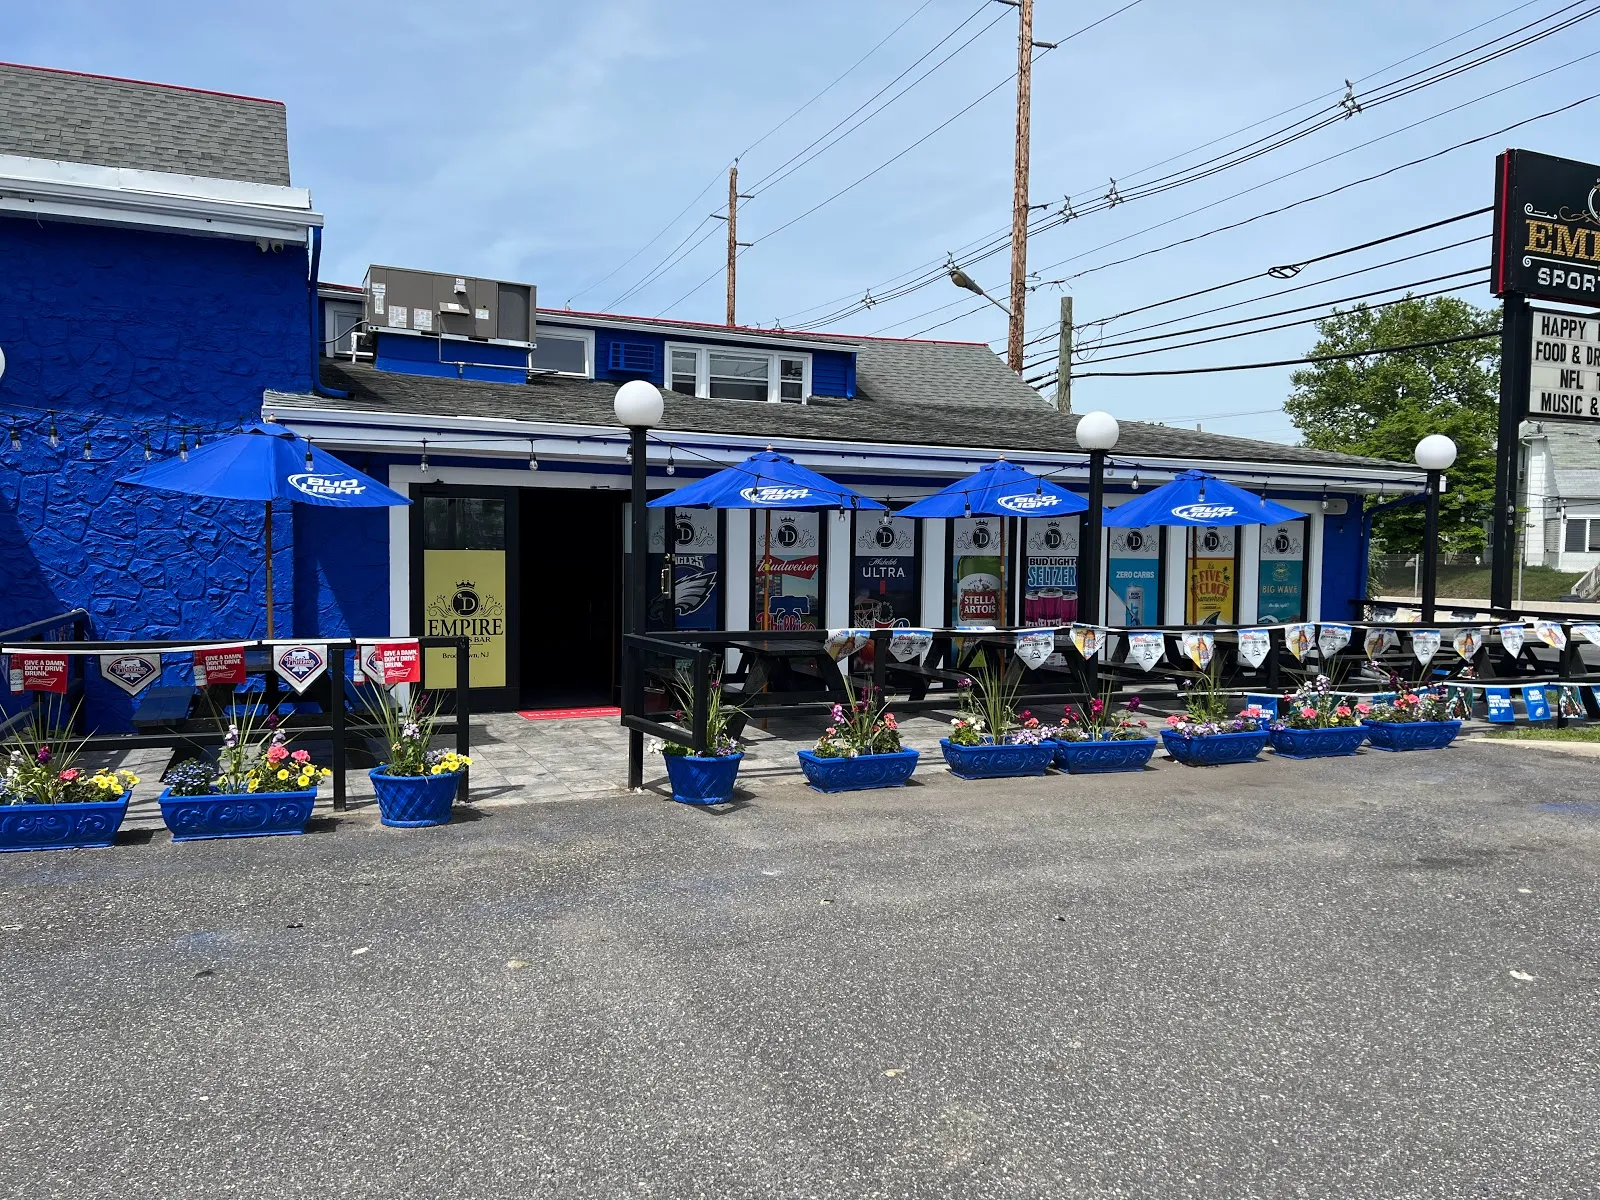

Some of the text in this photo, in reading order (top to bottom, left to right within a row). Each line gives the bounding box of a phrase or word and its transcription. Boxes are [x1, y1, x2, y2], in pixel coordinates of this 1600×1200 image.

[1537, 267, 1600, 292] SPOR
[1541, 315, 1586, 340] HAPPY
[1535, 340, 1567, 362] FOOD
[1572, 345, 1581, 365] &
[1560, 368, 1584, 390] NFL
[1541, 391, 1600, 416] MUSIC &
[307, 477, 358, 488] BUD
[301, 483, 367, 495] LIGHT
[1008, 499, 1062, 509] LIGHT
[1029, 558, 1076, 566] BUD LIGHT
[862, 566, 906, 578] ULTRA
[1028, 566, 1076, 586] SELTZER
[1133, 571, 1155, 579] CARBS
[1199, 570, 1222, 582] FIVE
[1262, 586, 1298, 594] BIG WAVE
[964, 595, 996, 604] STELLA
[963, 605, 996, 614] ARTOIS
[427, 618, 504, 637] EMPIRE
